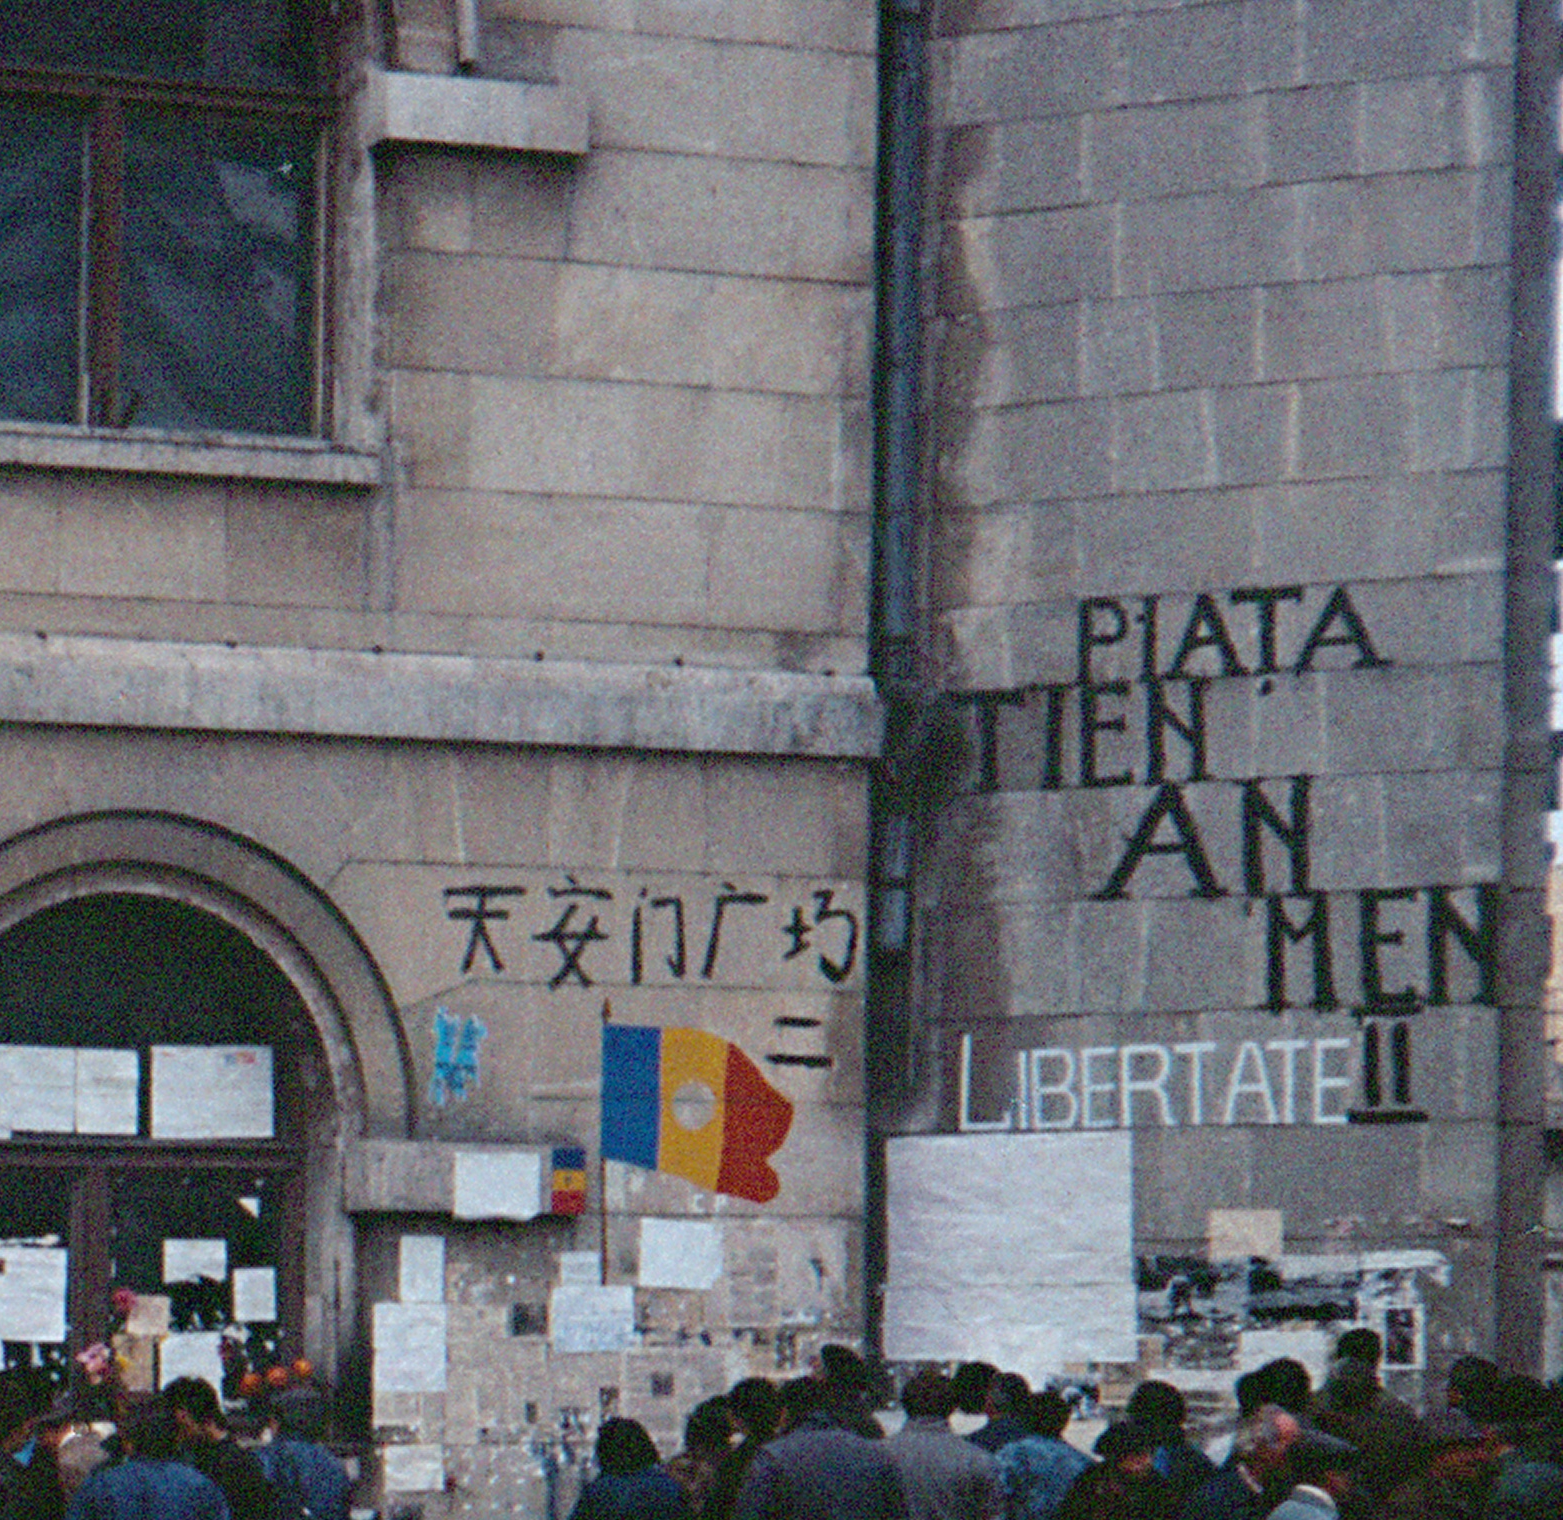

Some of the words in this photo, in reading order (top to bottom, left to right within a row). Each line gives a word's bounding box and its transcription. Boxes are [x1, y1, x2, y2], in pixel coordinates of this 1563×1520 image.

[945, 679, 1213, 790] TIEN
[1087, 775, 1315, 899] AN
[1265, 886, 1499, 1012] MEN
[958, 1032, 1352, 1131] LIBERTATE
